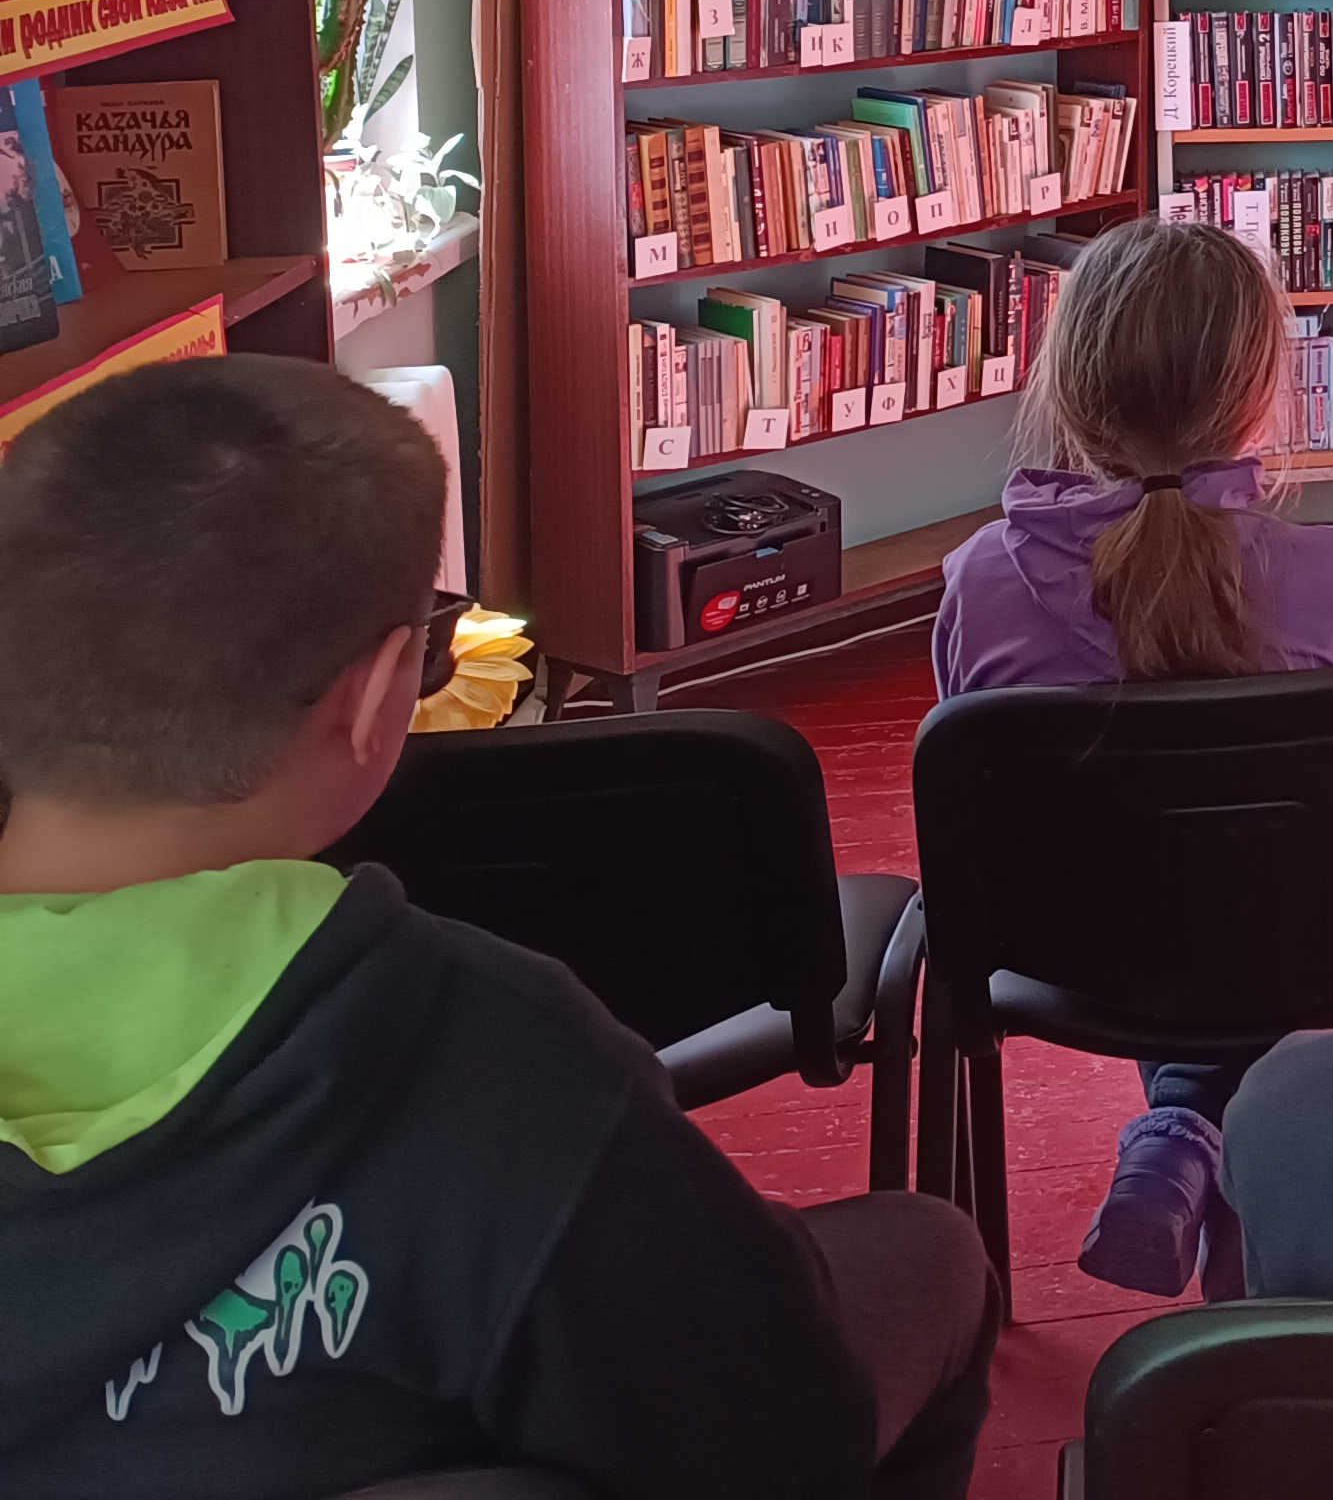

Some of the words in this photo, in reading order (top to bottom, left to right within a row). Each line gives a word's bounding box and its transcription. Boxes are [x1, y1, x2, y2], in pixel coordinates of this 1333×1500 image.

[709, 9, 719, 25] З
[1021, 20, 1032, 33] Л
[832, 38, 843, 53] К
[631, 53, 645, 69] Ж
[1163, 27, 1180, 98] Корецкий
[1164, 104, 1178, 119] Д.
[1041, 187, 1049, 200] Р
[887, 209, 899, 226] О
[930, 204, 943, 218] П
[825, 221, 838, 237] Н
[649, 245, 667, 262] М
[993, 367, 1006, 382] Ц
[947, 376, 958, 391] Х
[843, 401, 855, 417] У
[881, 396, 896, 411] Ф
[762, 417, 776, 433] Т
[658, 439, 674, 455] С
[743, 574, 786, 592] PANTUM
